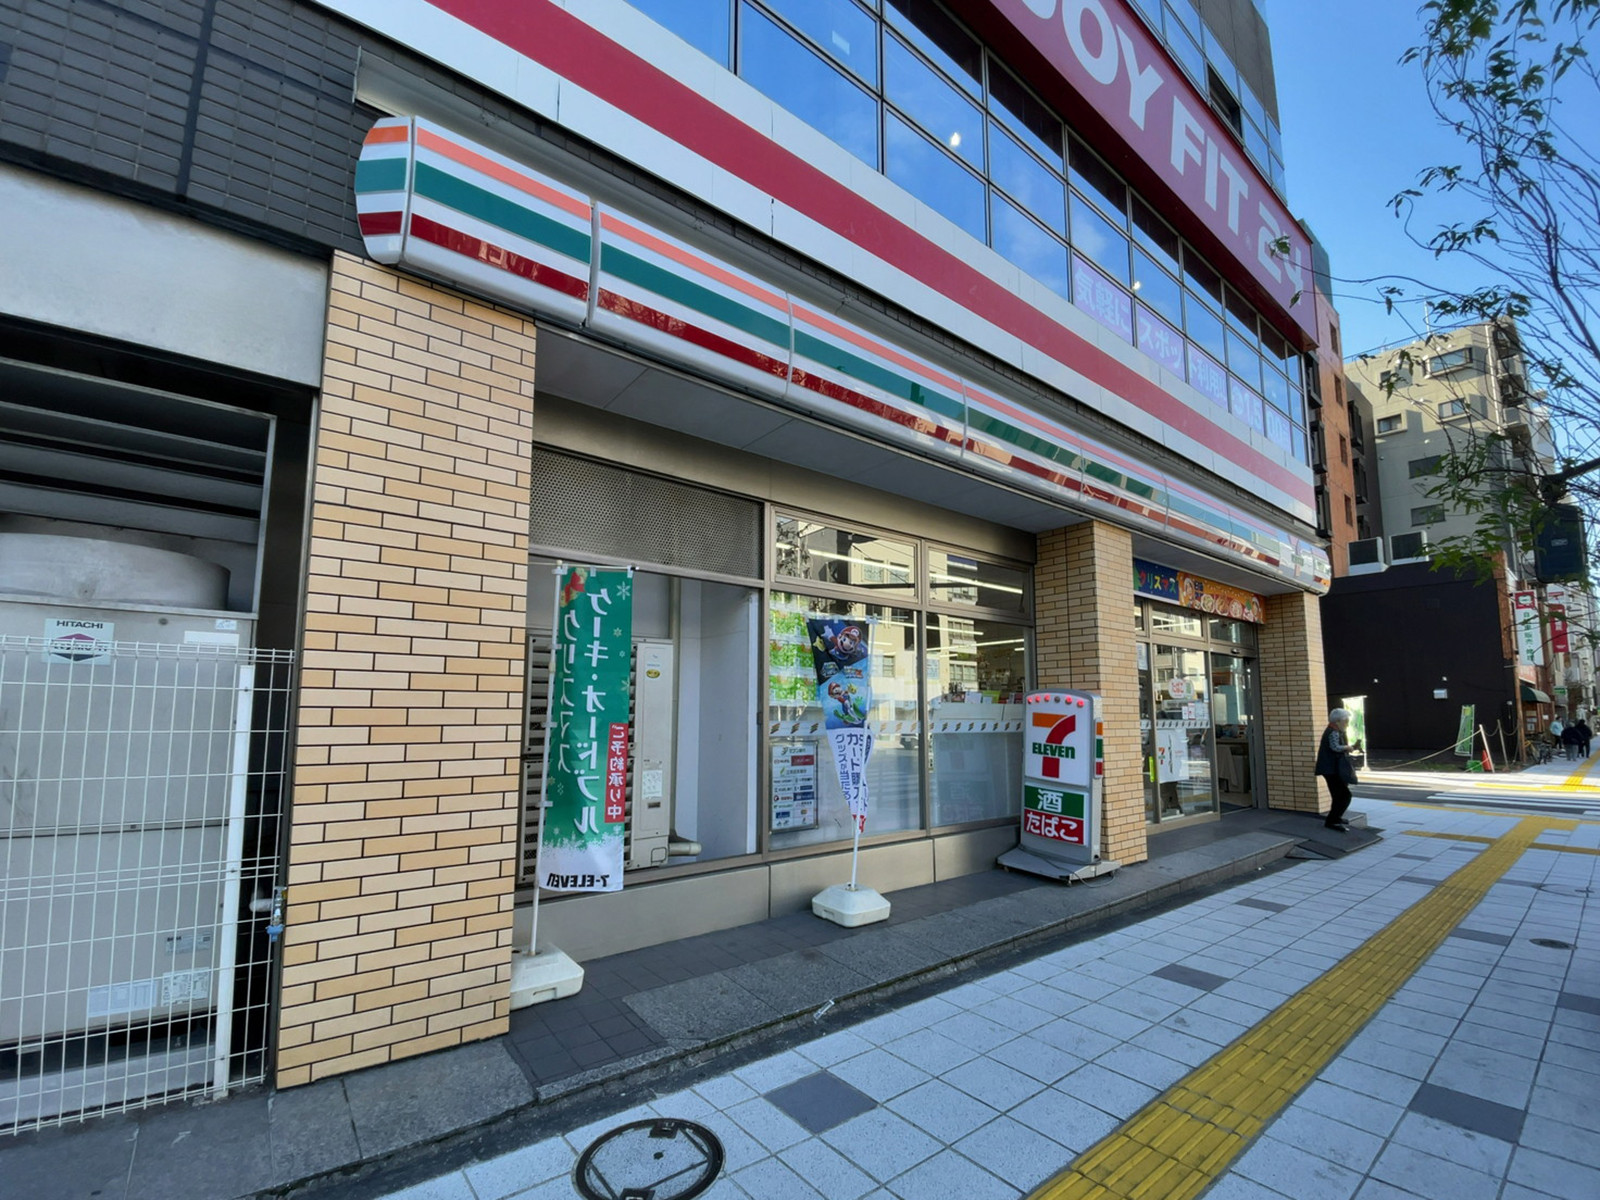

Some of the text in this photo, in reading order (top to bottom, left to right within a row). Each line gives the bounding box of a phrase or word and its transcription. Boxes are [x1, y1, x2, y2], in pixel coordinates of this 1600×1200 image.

[1022, 0, 1303, 305] OY FIT 24
[1139, 570, 1177, 594] クリスマス
[56, 620, 103, 629] HITACHI
[1037, 788, 1063, 813] 酒
[1026, 812, 1079, 842] たばこ
